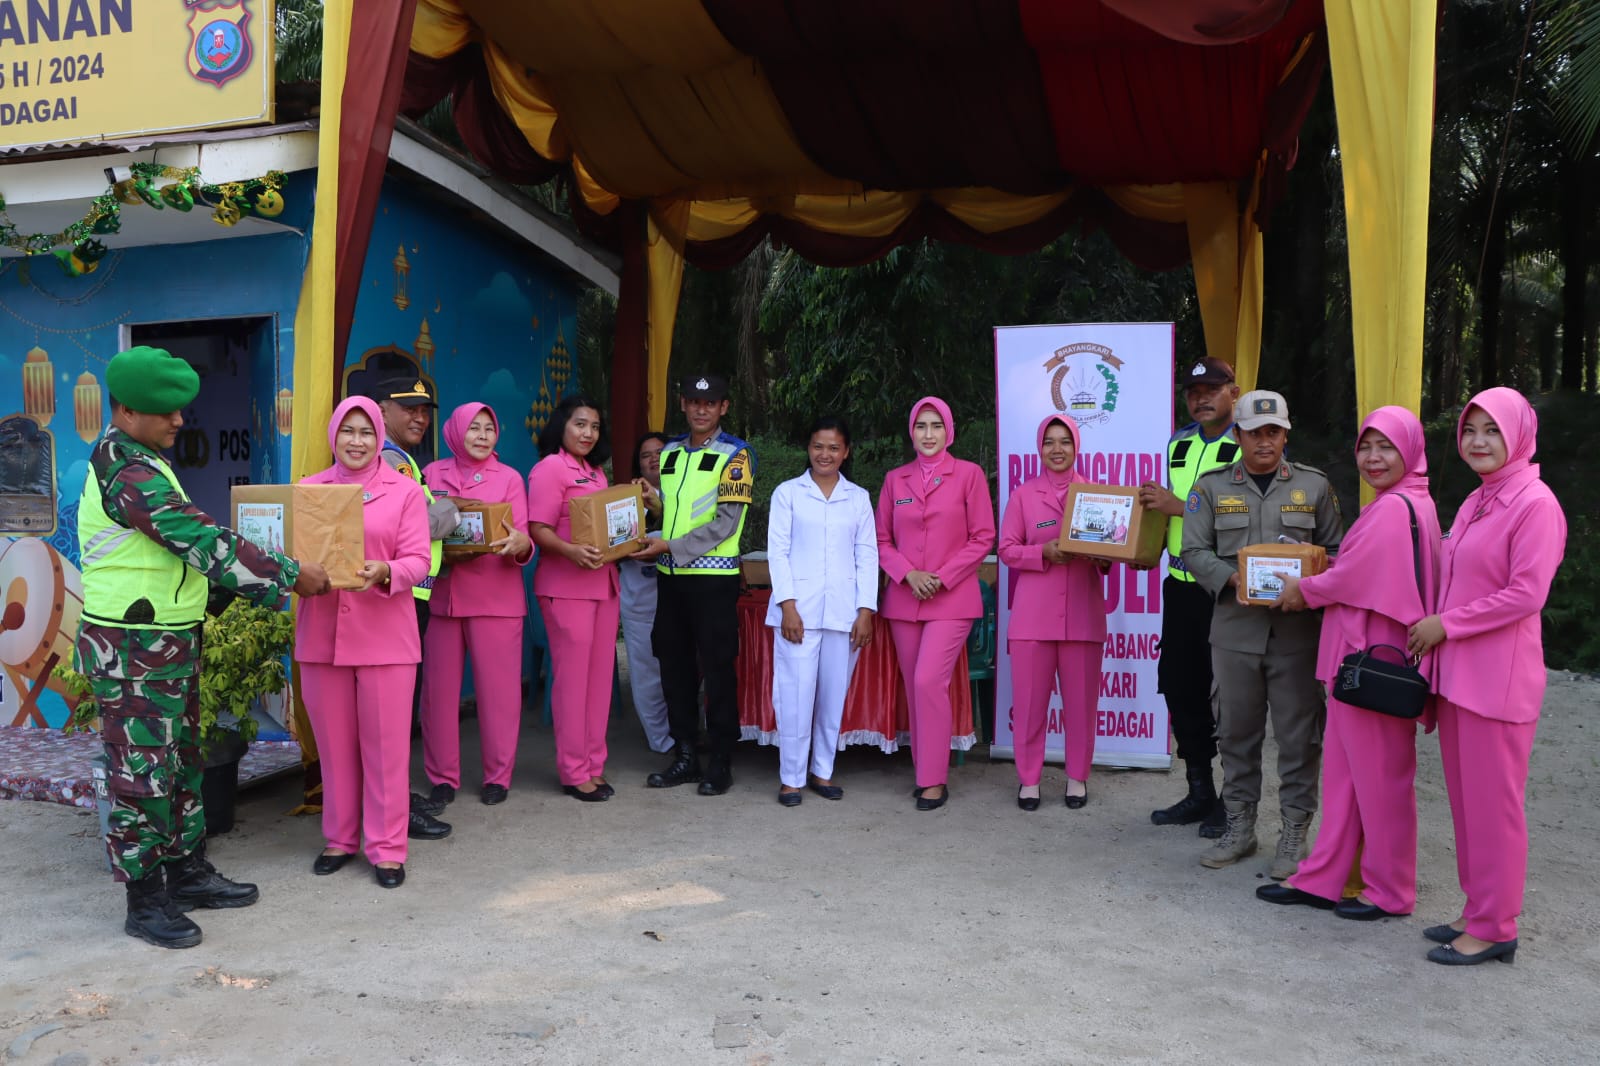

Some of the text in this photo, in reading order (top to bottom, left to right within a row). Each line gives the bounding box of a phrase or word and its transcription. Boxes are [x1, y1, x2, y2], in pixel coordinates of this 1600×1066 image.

[13, 61, 29, 88] H
[49, 52, 104, 84] 2024
[0, 96, 78, 126] DAGAI
[1057, 344, 1110, 358] BHAYANGKARI
[220, 428, 250, 462] POS
[1101, 633, 1161, 661] ABANG
[1096, 710, 1154, 739] EDAGAI
